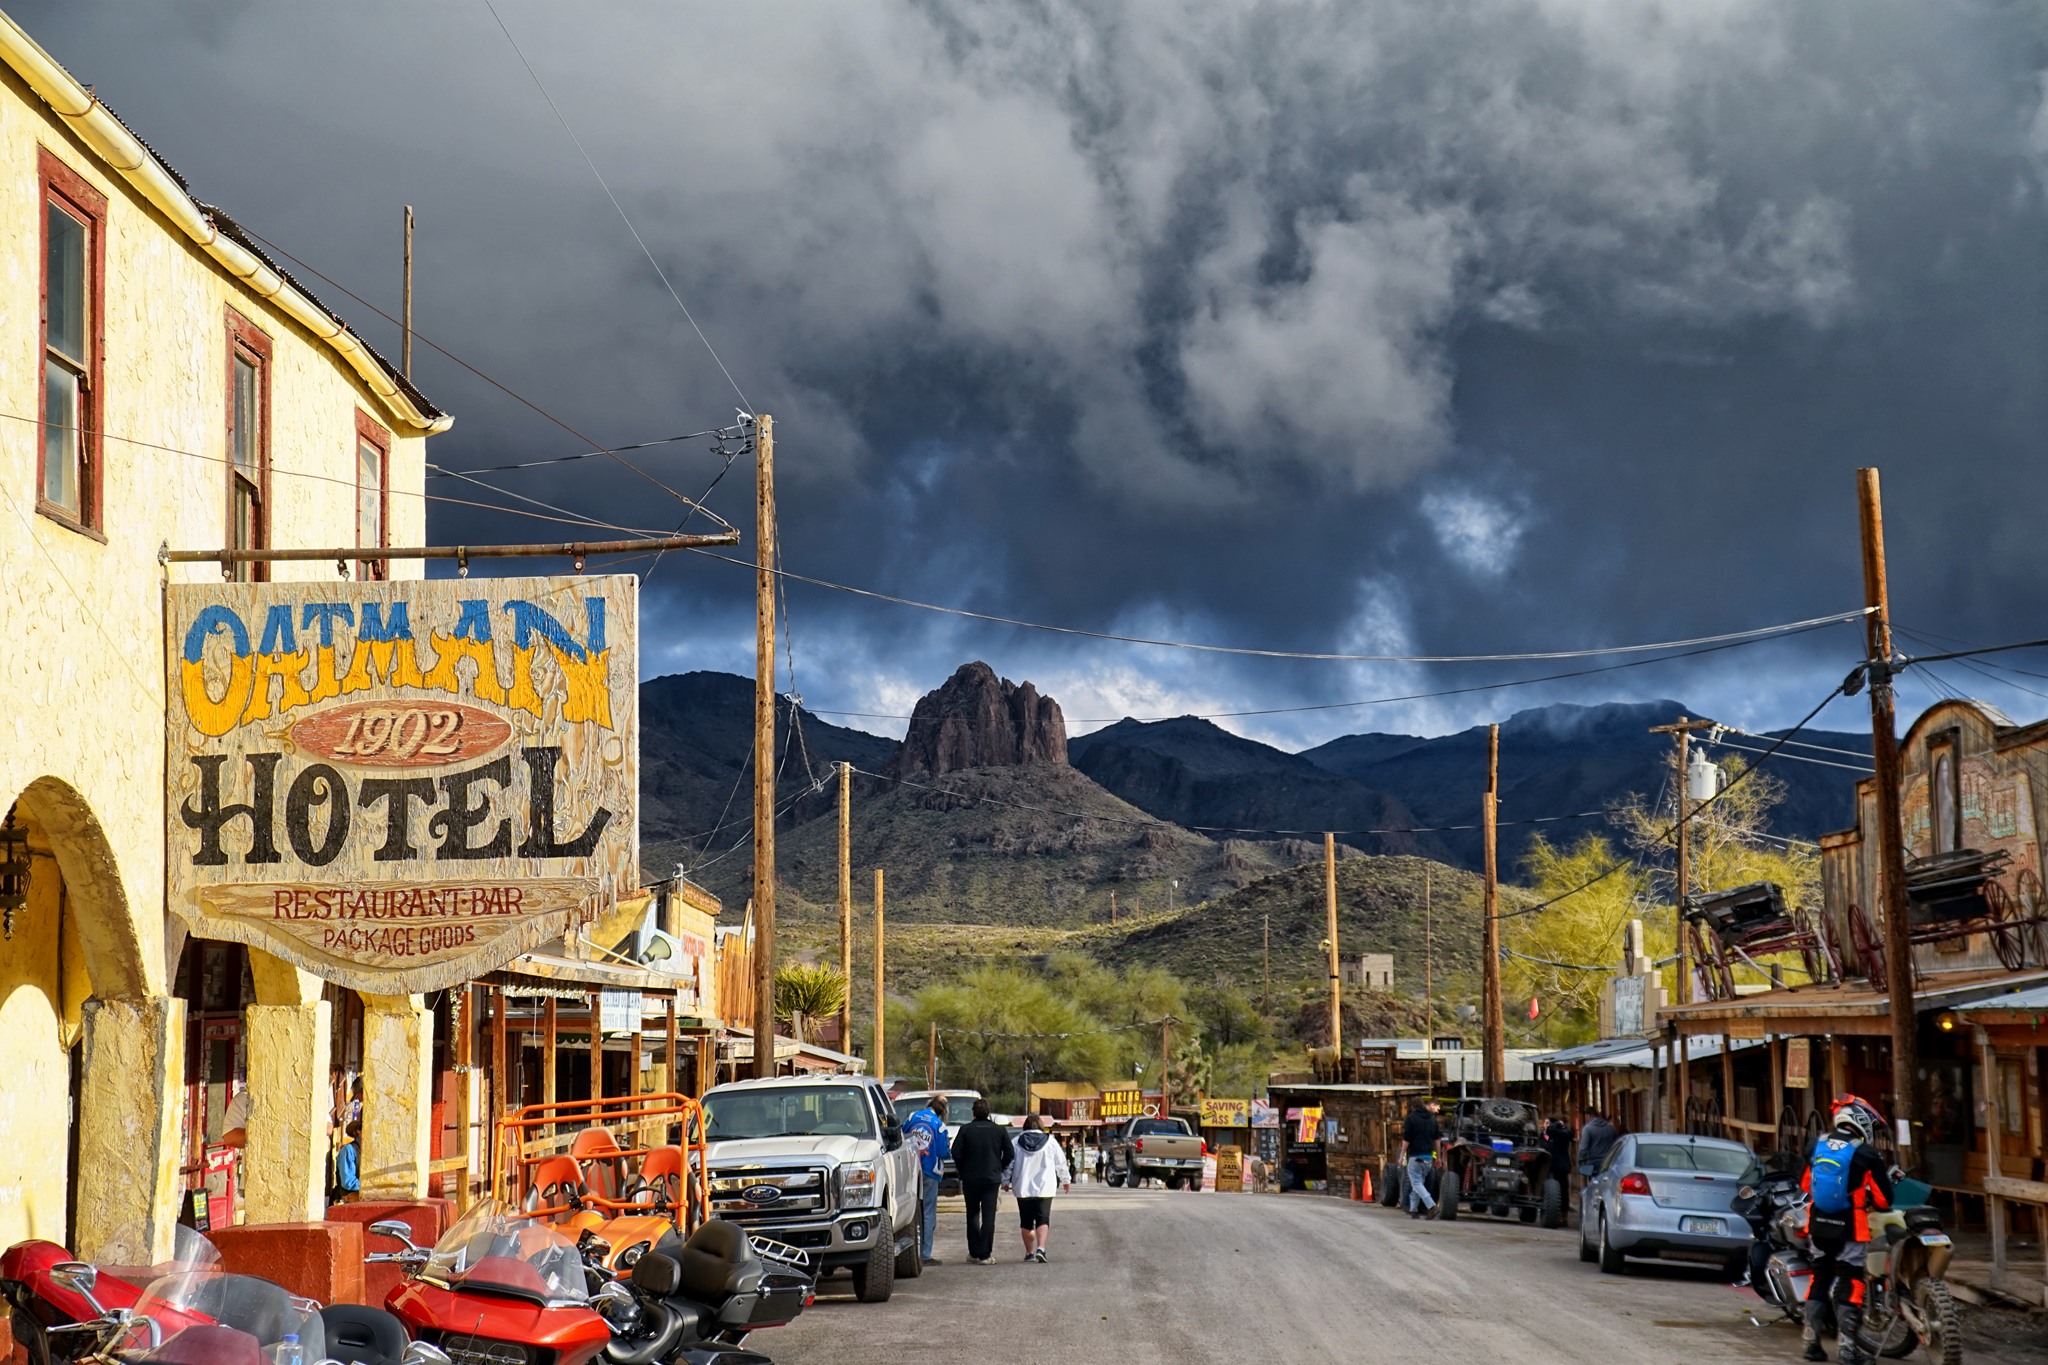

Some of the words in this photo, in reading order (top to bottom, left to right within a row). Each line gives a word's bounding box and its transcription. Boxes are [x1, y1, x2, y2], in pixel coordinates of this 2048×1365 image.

[181, 597, 614, 737] OATMAN
[333, 708, 464, 759] 1902
[181, 746, 612, 867] HOTEL
[324, 927, 416, 957] PACKAGE
[419, 925, 475, 955] GOODS
[1105, 1091, 1140, 1103] MAKING
[1205, 1101, 1244, 1111] SAVING
[1101, 1104, 1143, 1116] MEMORIES
[1212, 1114, 1229, 1125] ASS
